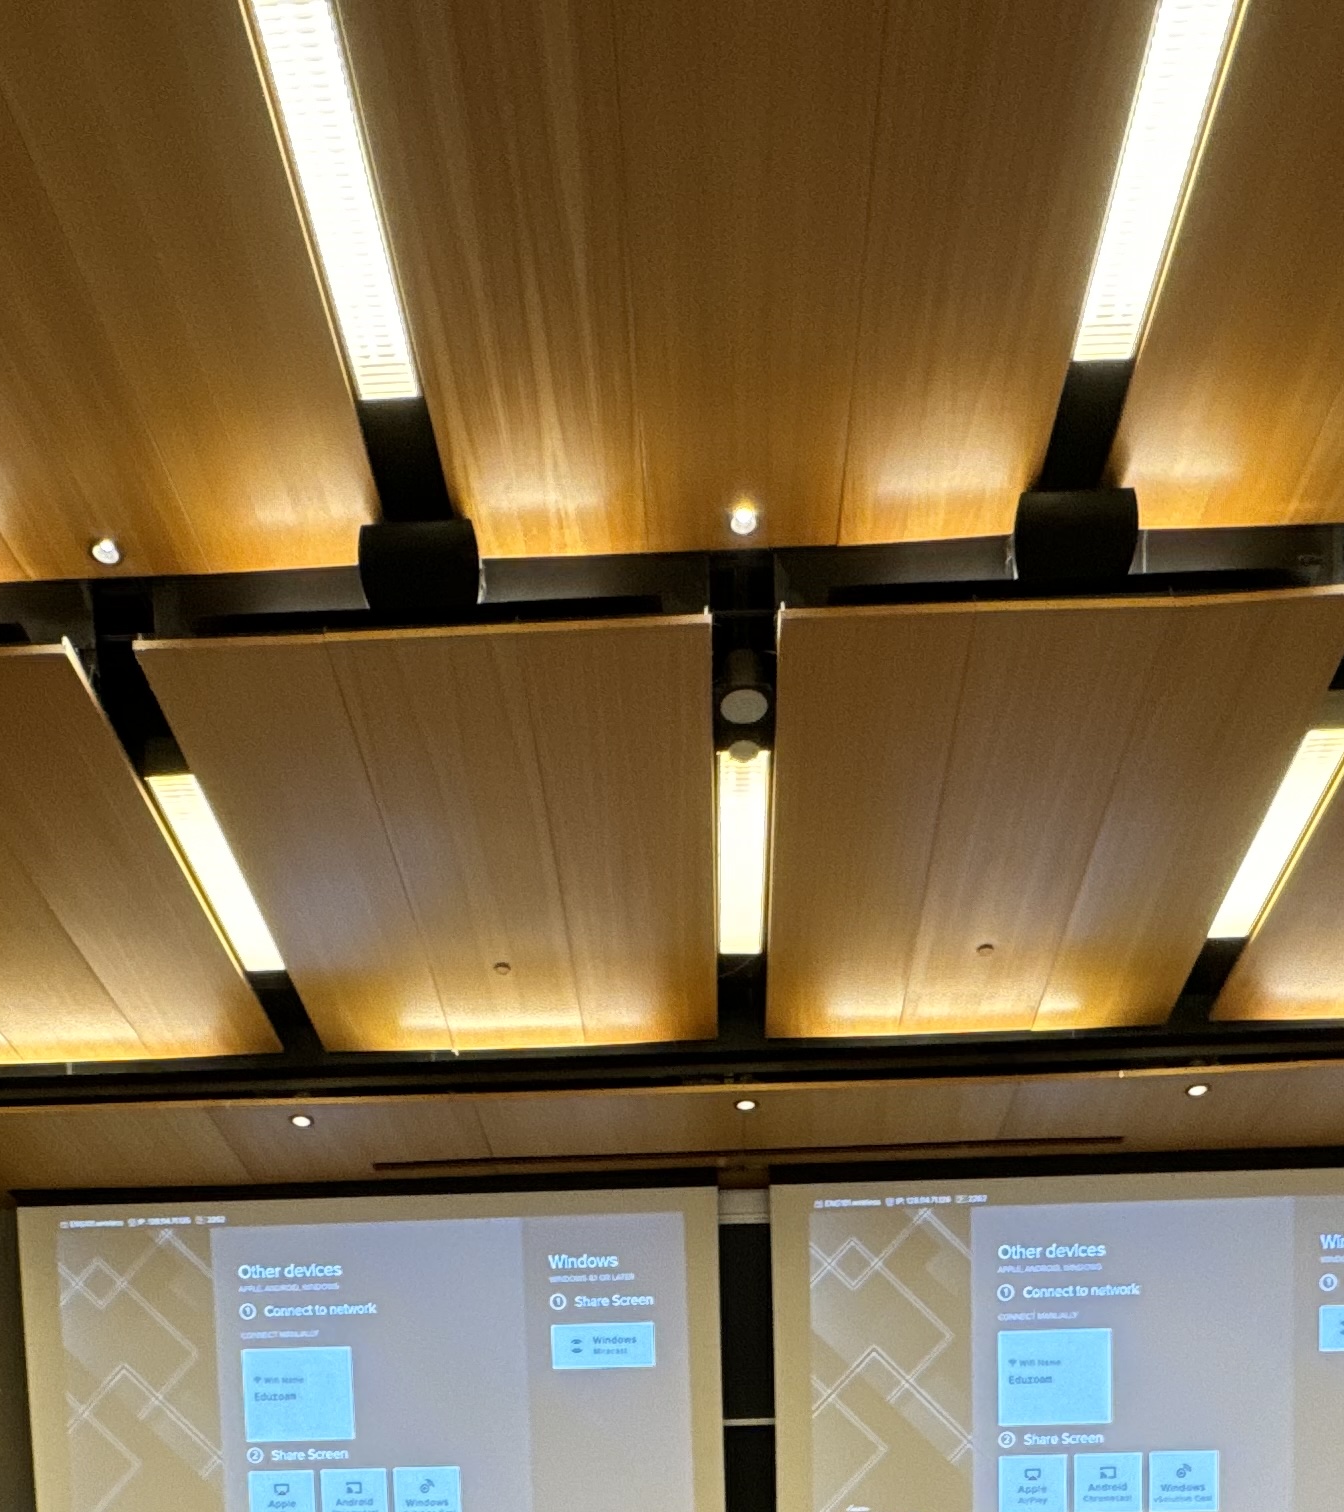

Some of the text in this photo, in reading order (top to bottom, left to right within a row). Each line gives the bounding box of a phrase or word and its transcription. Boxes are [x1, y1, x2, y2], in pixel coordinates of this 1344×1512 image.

[997, 1243, 1107, 1260] Other devices
[548, 1253, 619, 1270] Windows
[237, 1263, 344, 1280] Other devices
[1022, 1285, 1074, 1299] Connect
[1075, 1285, 1088, 1297] to
[1090, 1283, 1141, 1296] network
[573, 1295, 610, 1308] Share
[611, 1294, 654, 1307] Screen
[263, 1305, 313, 1318] Connect
[314, 1304, 327, 1316] to
[329, 1302, 378, 1316] network
[592, 1335, 637, 1344] Windows
[1008, 1375, 1053, 1385] Eduroam
[254, 1392, 297, 1402] Eduroam
[1023, 1433, 1059, 1446] Share
[1061, 1432, 1105, 1445] Screen
[271, 1449, 306, 1462] Share
[307, 1448, 349, 1460] Screen
[1017, 1485, 1048, 1495] Apple
[1087, 1483, 1128, 1492] Android
[1160, 1483, 1206, 1492] Windows
[268, 1499, 297, 1509] Apple
[335, 1498, 374, 1507] Android
[405, 1499, 449, 1507] Windows
